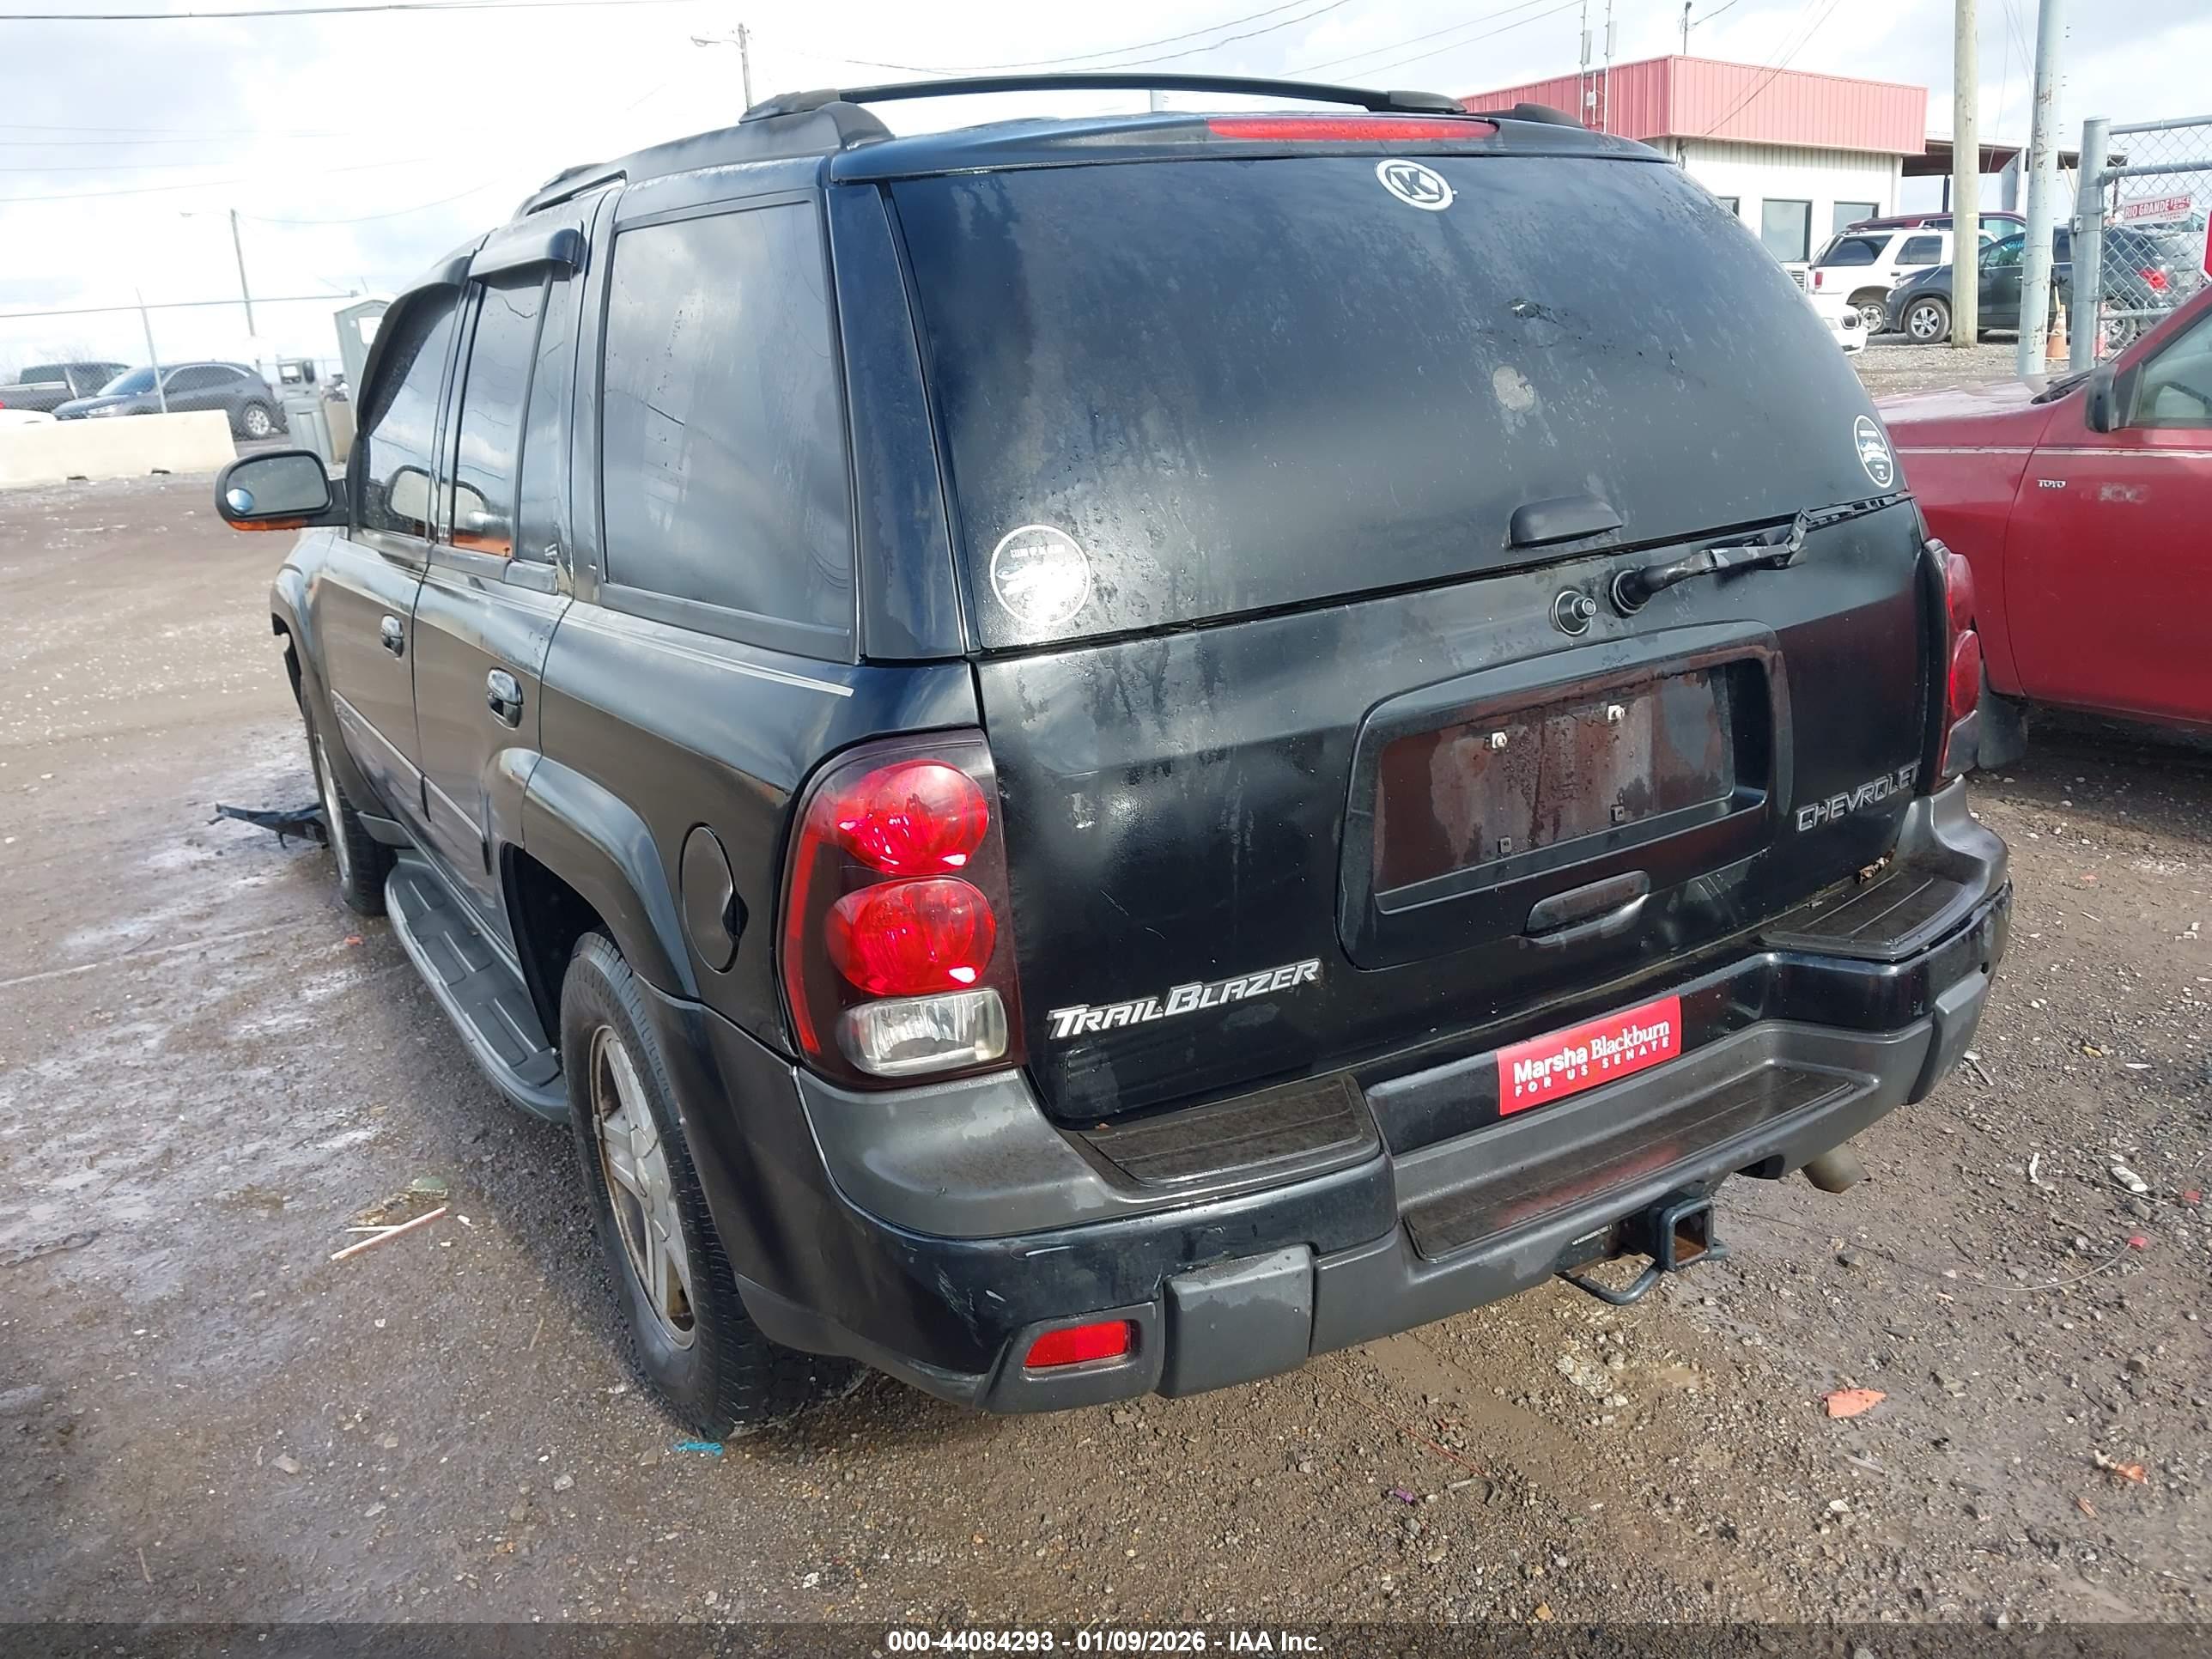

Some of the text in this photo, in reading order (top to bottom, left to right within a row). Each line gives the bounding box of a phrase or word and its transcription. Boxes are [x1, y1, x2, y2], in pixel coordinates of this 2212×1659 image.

[2125, 206, 2138, 218] RIO
[2138, 199, 2169, 216] GRANDE
[1796, 761, 1922, 832] CHEVROLET
[1513, 1021, 1669, 1085] Marsha Blackburn
[1515, 1036, 1669, 1097] FOR US SENATE
